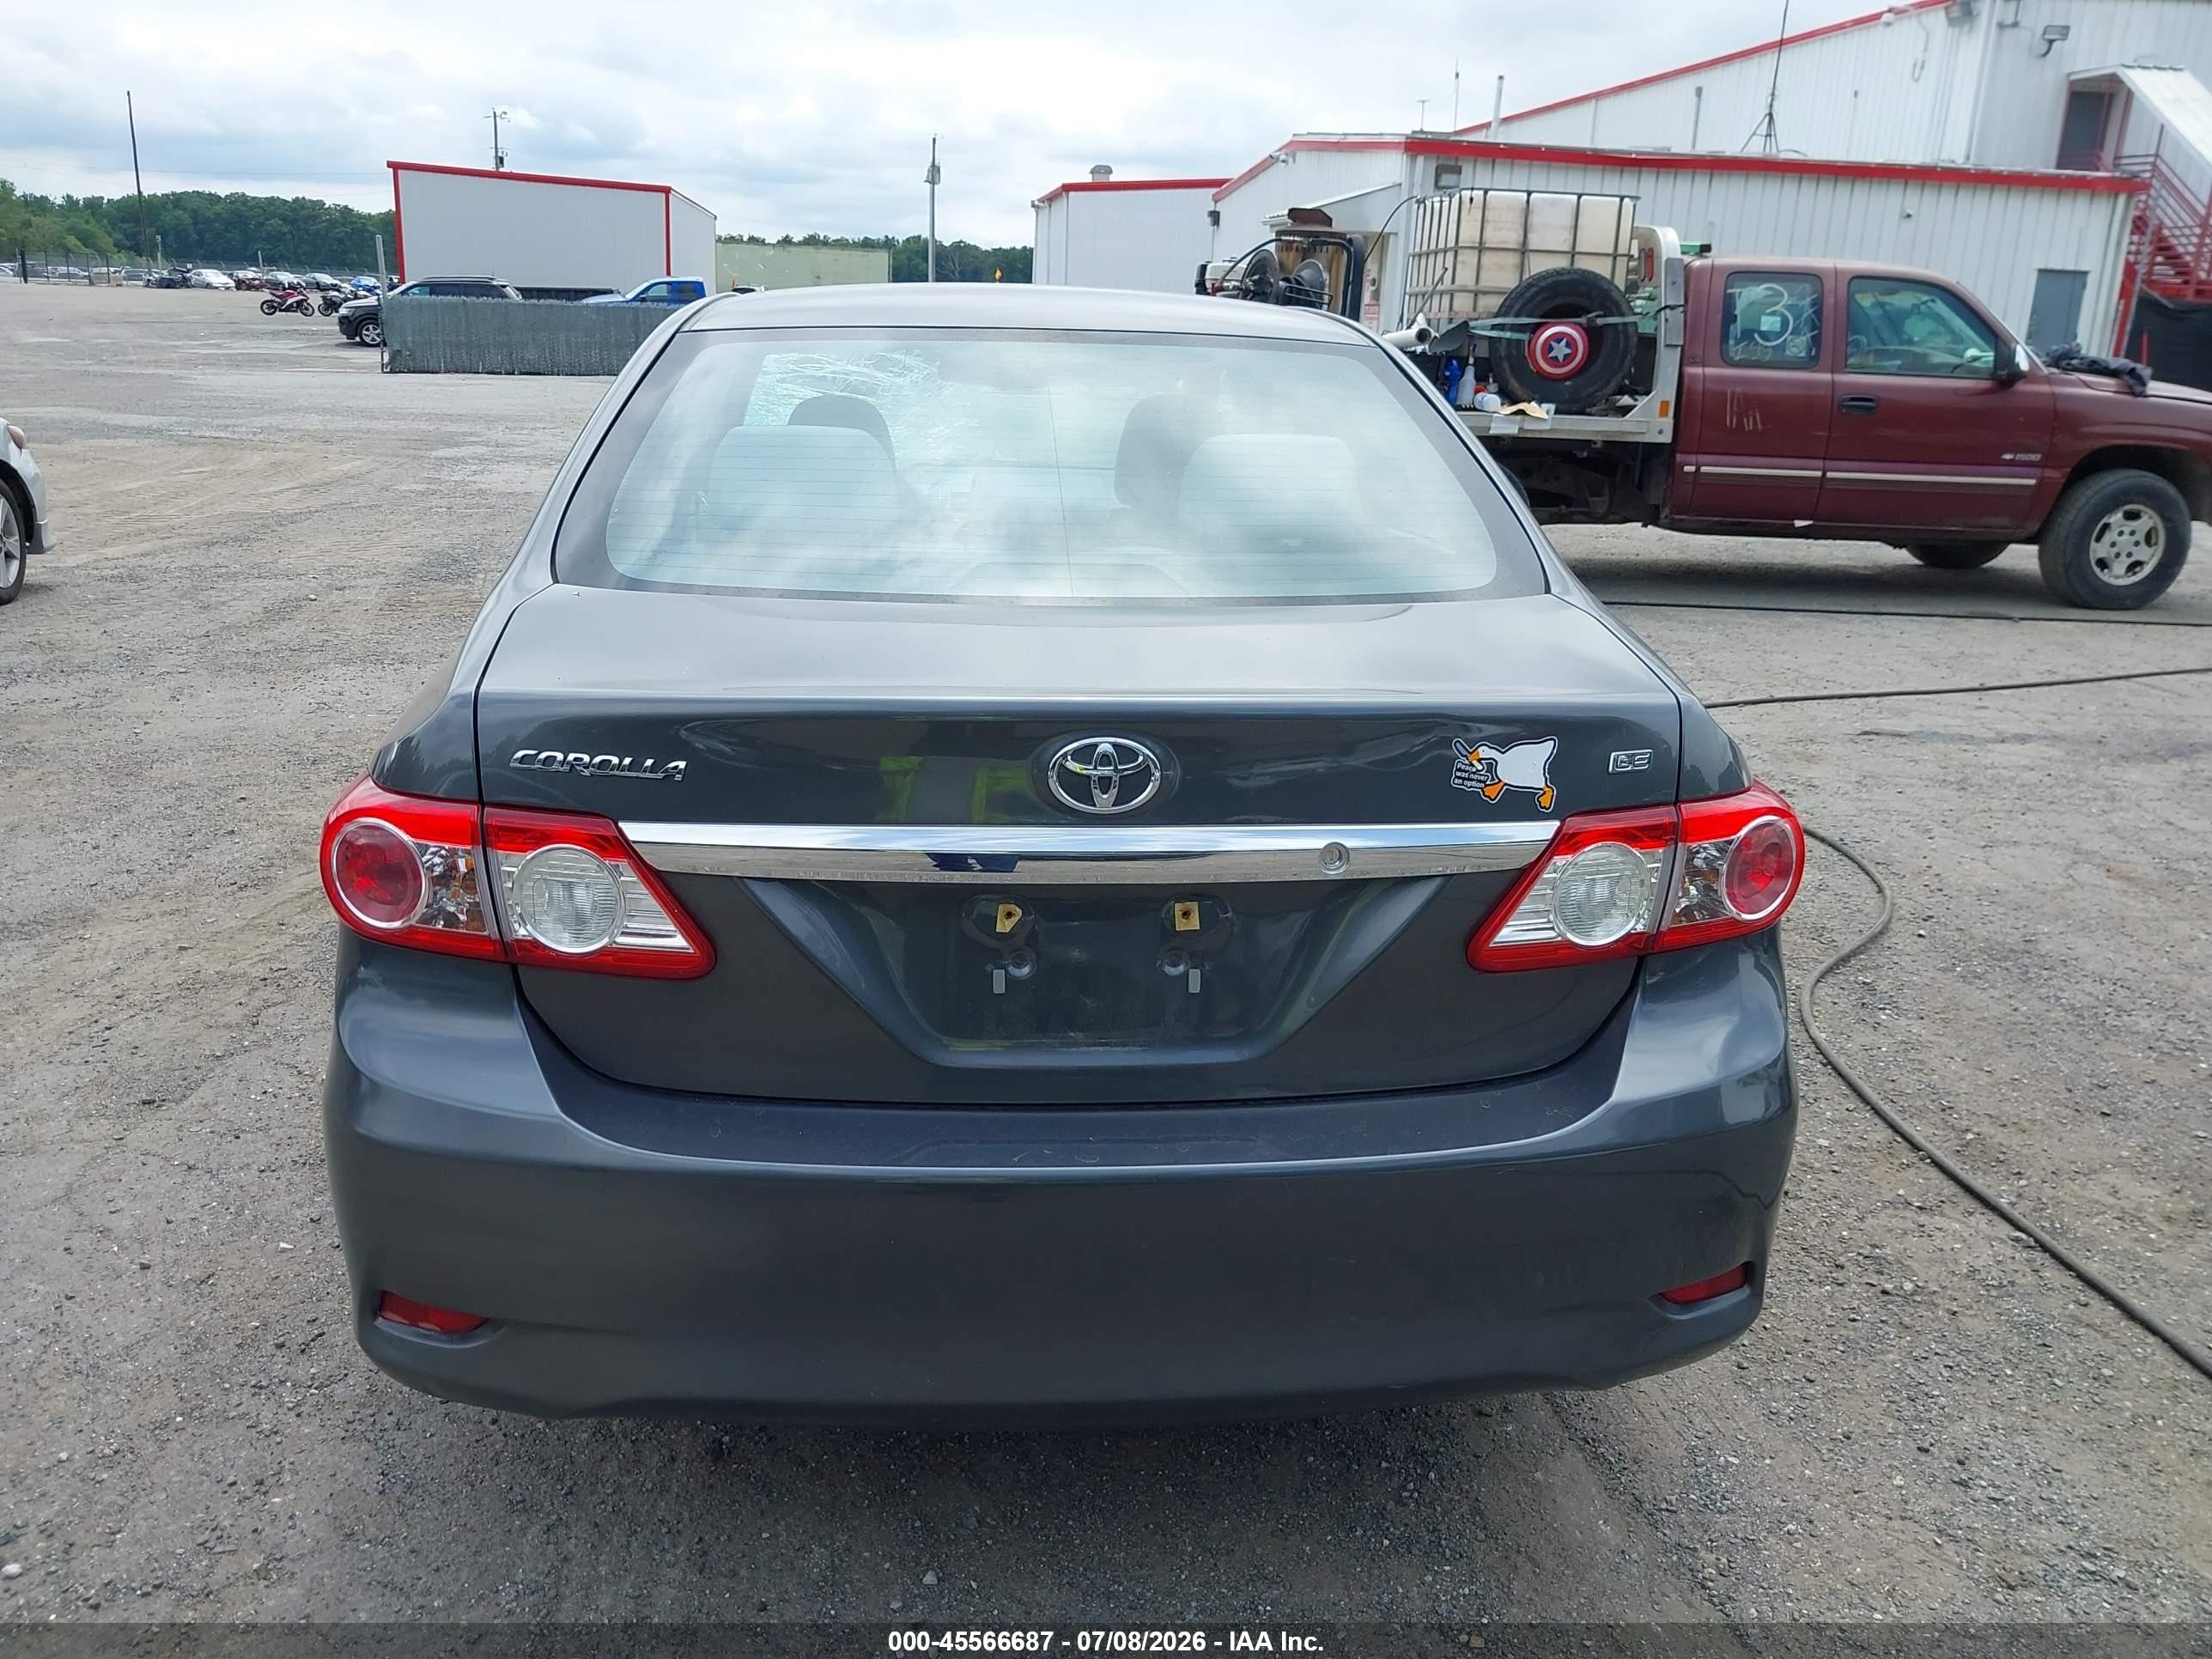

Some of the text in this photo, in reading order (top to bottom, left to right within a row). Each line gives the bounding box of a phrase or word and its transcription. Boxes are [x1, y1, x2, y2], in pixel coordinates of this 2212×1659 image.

[509, 749, 687, 781] COROLLA
[1455, 770, 1489, 781] was never
[1462, 780, 1486, 788] option
